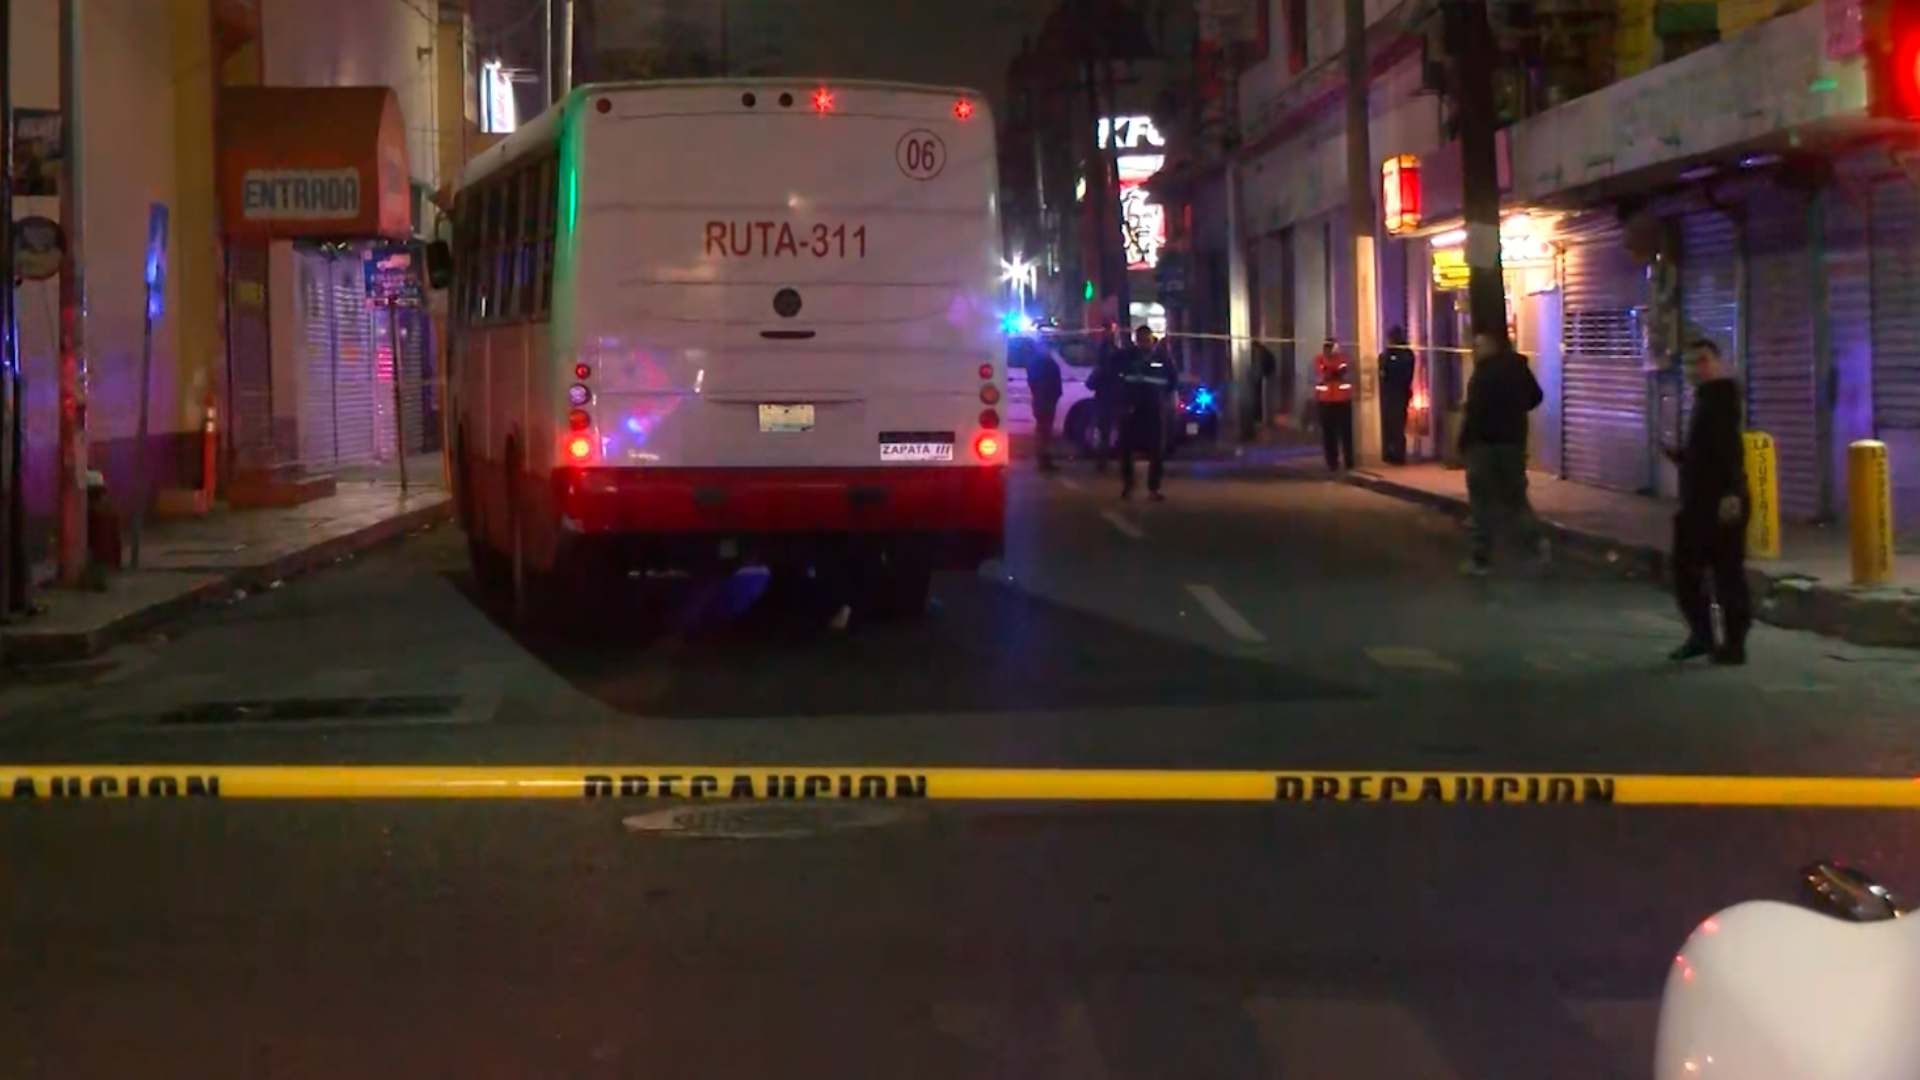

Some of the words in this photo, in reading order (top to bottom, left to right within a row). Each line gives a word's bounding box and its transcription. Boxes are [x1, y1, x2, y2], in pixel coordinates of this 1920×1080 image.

[906, 138, 936, 171] 06
[244, 176, 357, 211] ENTRADA
[705, 221, 867, 259] RUTA-311
[882, 445, 931, 455] ZAPATA
